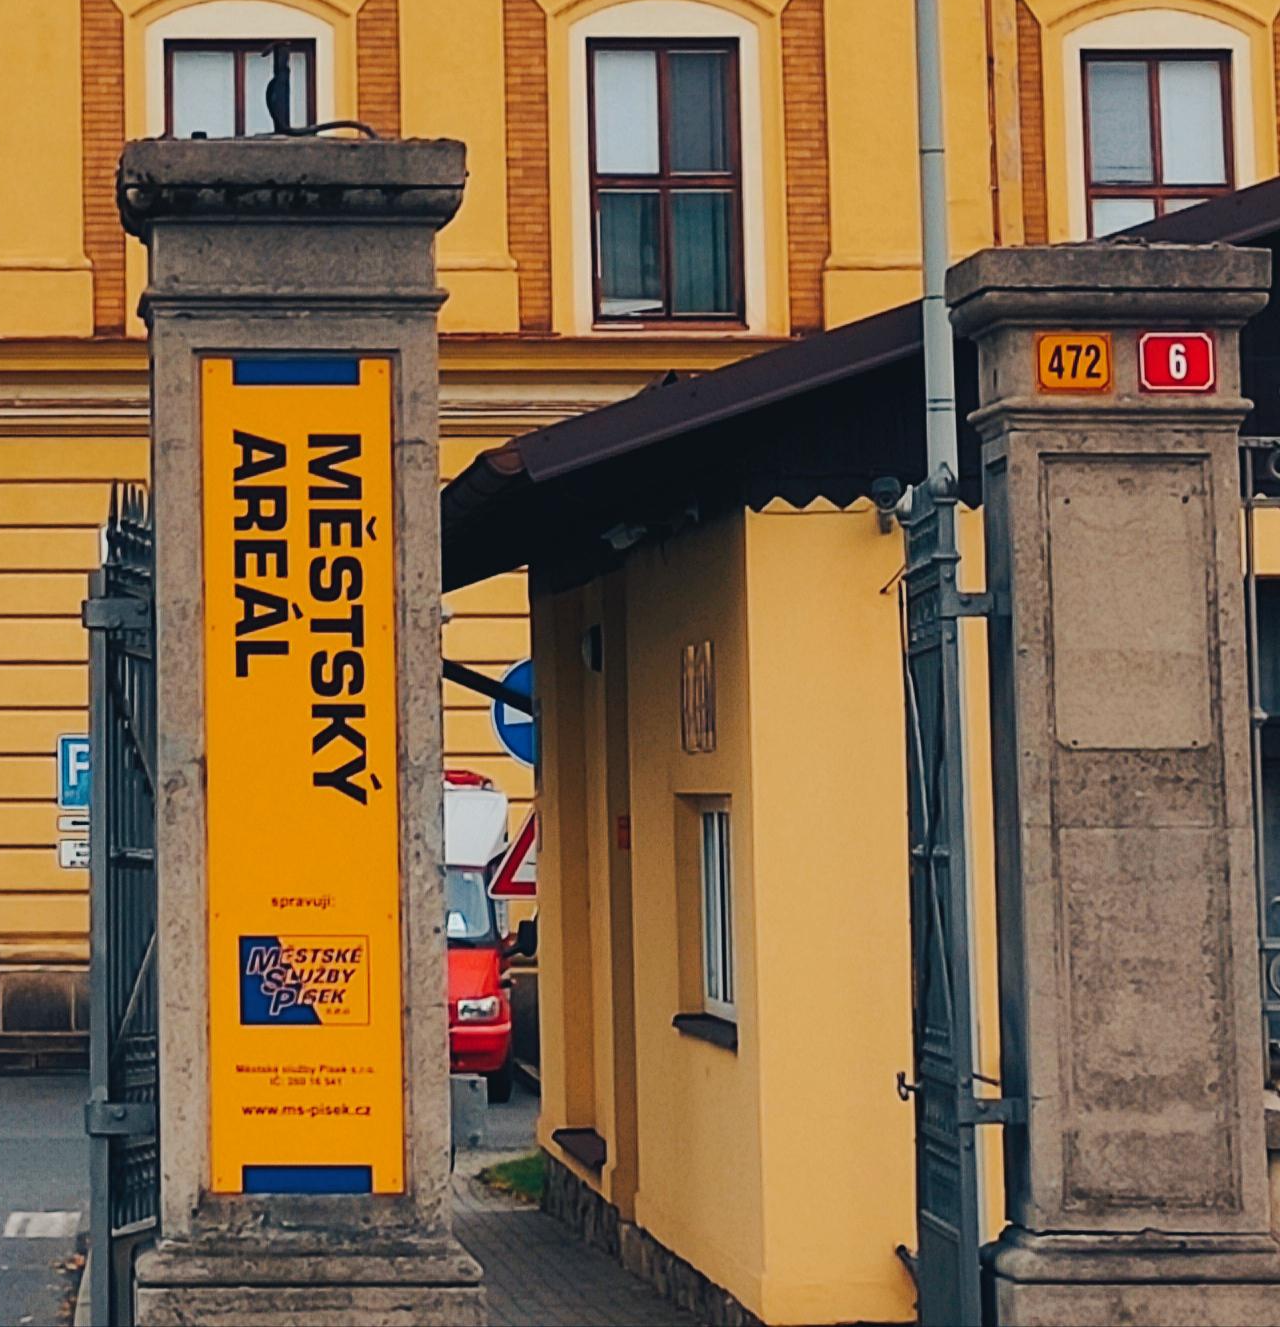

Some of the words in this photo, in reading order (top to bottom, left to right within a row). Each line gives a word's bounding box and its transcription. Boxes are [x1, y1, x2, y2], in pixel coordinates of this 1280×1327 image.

[1047, 343, 1102, 380] 472
[1168, 342, 1188, 381] 6
[232, 429, 303, 678] AREÁL
[307, 433, 382, 805] MĚSTSKÝ
